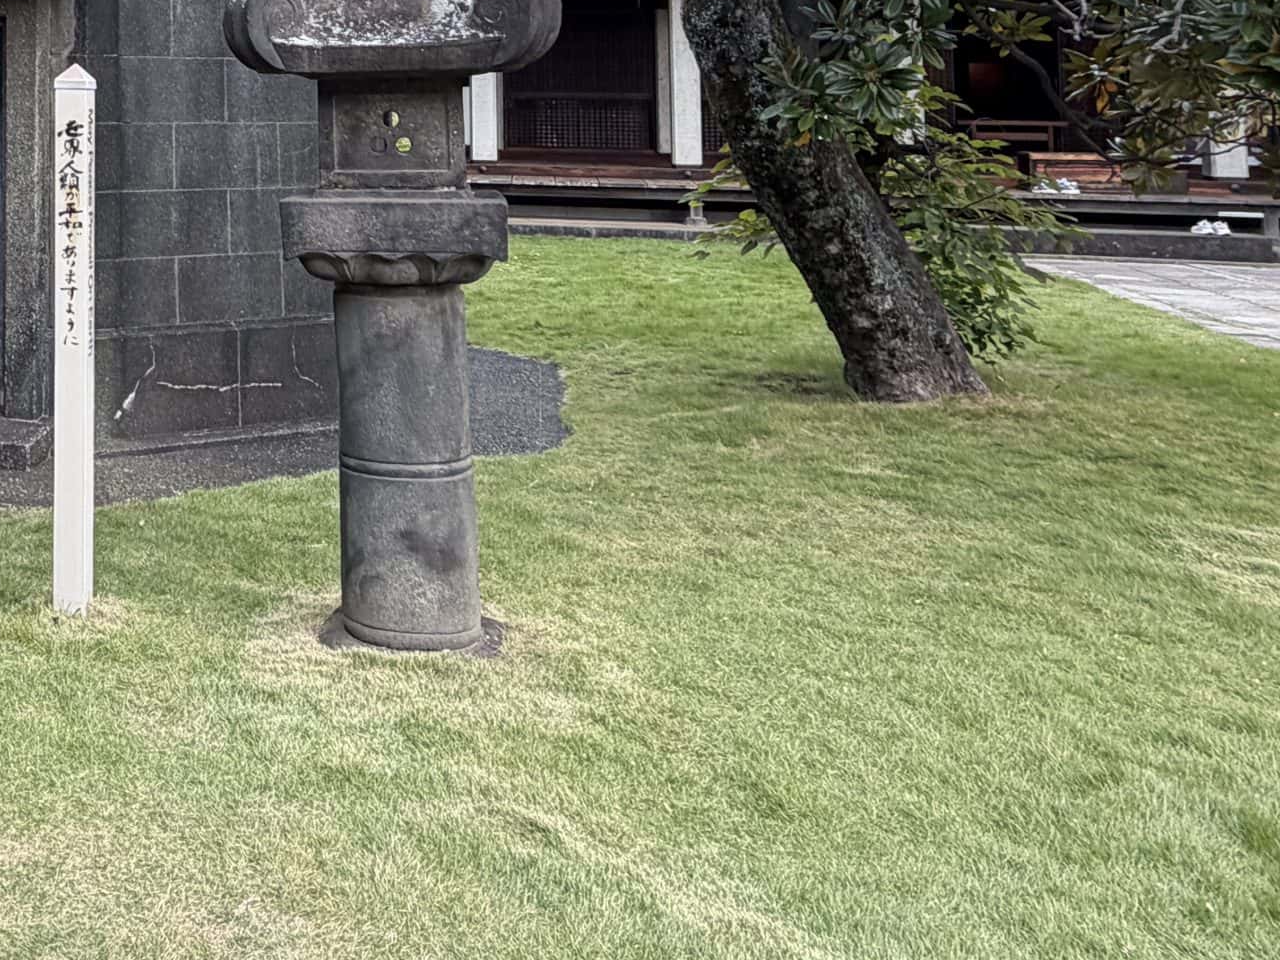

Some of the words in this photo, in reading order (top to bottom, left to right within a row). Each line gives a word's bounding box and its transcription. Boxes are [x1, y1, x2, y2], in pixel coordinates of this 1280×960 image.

[57, 119, 85, 347] 世界人類が平和でありますように
